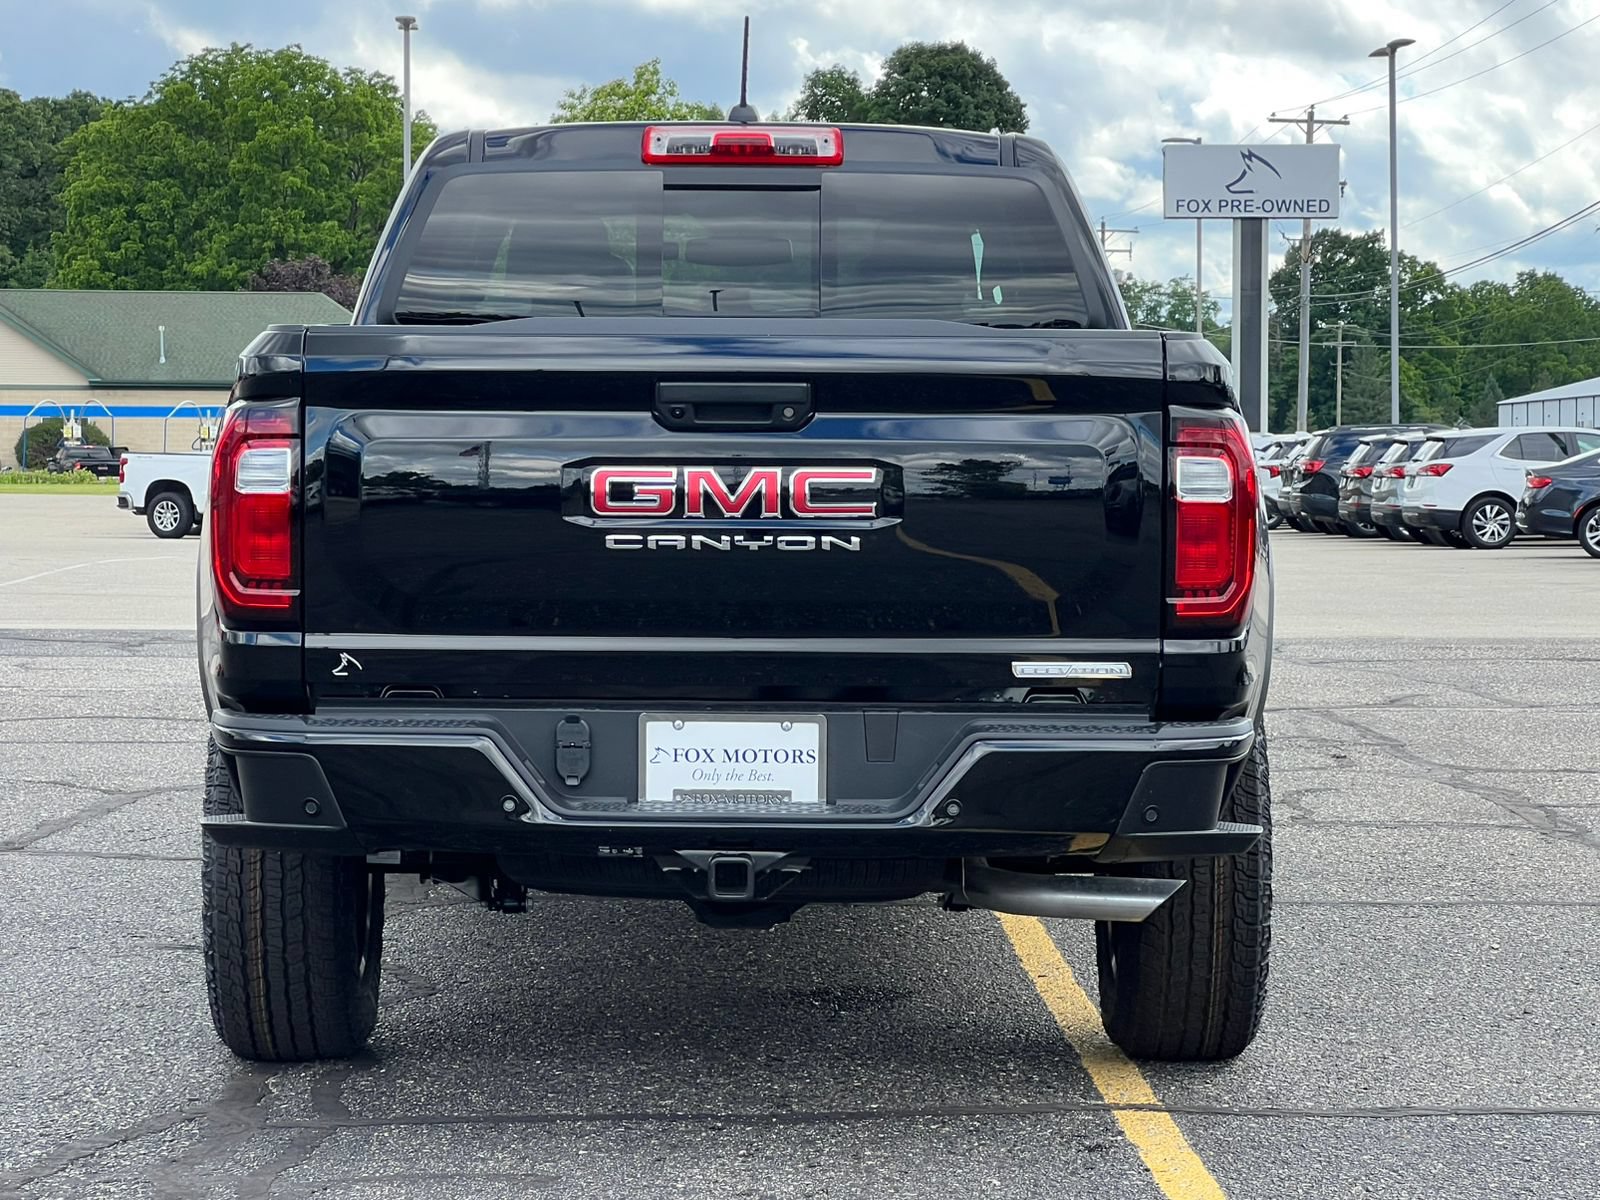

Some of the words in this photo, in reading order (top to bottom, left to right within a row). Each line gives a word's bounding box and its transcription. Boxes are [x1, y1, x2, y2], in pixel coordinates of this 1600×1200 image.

[1175, 199, 1212, 213] FOX
[1218, 199, 1330, 213] PRE-OWNED
[590, 466, 877, 518] GMC
[605, 534, 861, 551] CANYON
[1020, 666, 1124, 676] ELEVATION
[673, 748, 715, 764] FOX
[722, 748, 816, 765] MOTORS
[691, 768, 722, 785] Only
[726, 768, 744, 782] the
[748, 769, 775, 782] Best.
